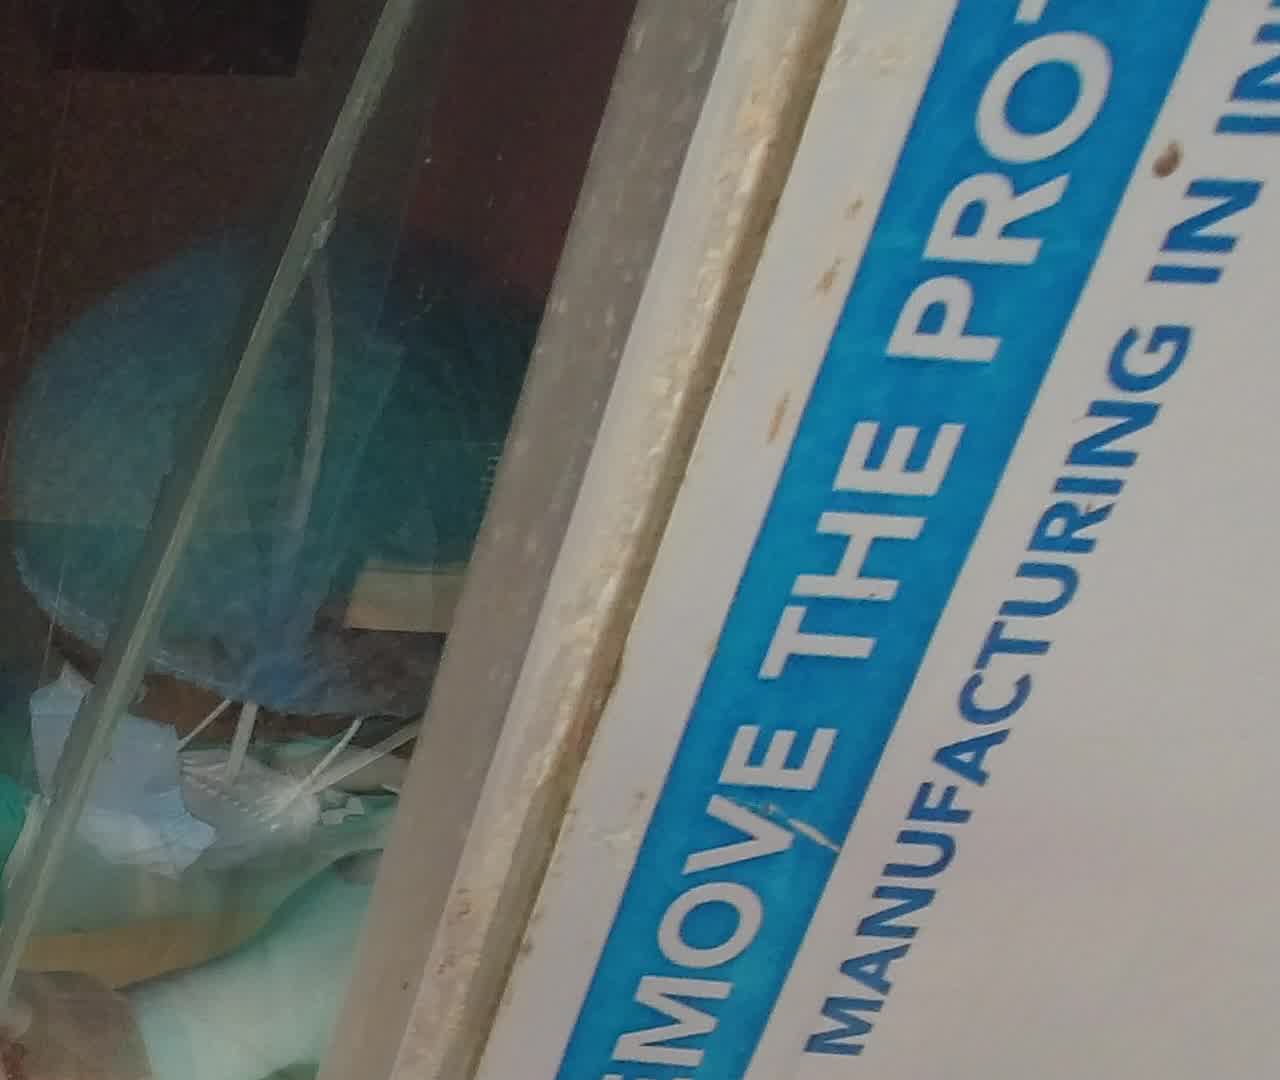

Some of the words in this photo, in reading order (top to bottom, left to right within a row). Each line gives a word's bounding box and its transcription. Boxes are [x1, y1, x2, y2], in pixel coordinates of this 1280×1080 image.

[759, 421, 966, 680] THE
[886, 0, 1113, 362] PRO
[805, 323, 1192, 1056] MANUFACTURING
[1149, 176, 1263, 285] IN
